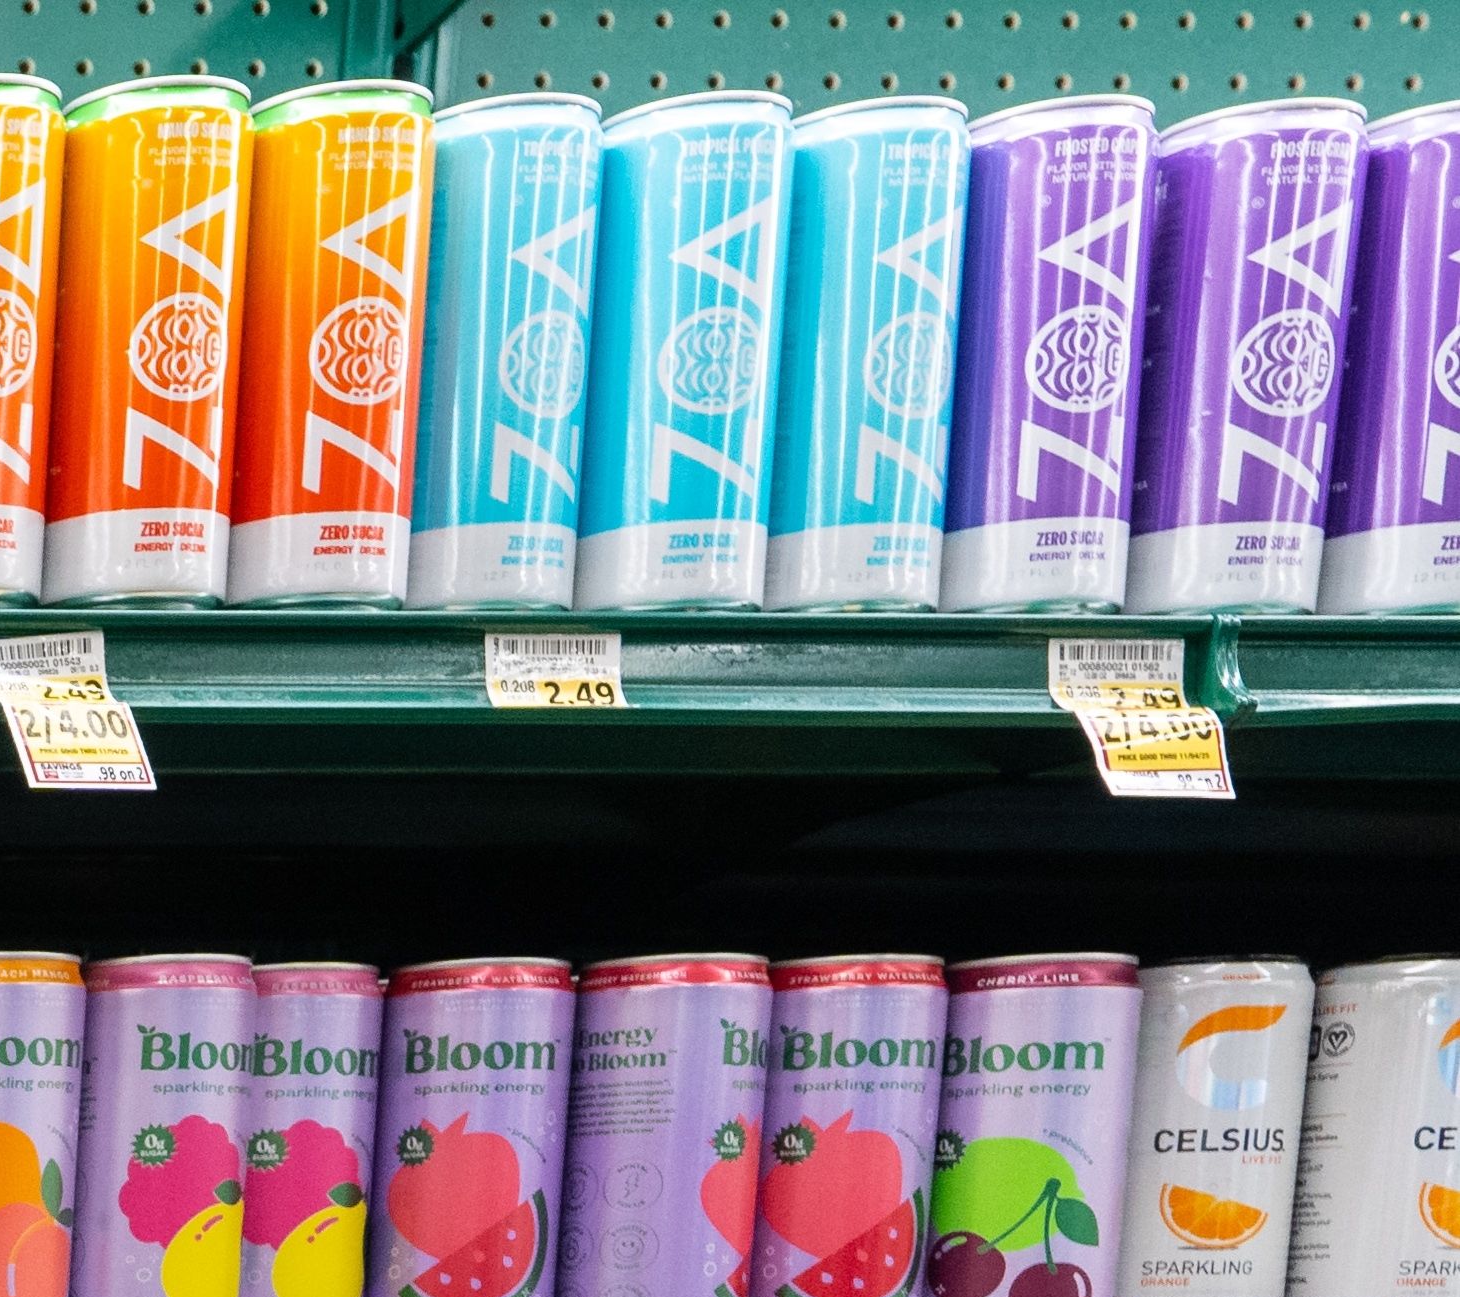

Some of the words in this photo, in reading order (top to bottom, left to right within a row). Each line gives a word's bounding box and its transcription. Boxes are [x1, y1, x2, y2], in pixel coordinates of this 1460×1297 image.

[501, 679, 535, 694] 0.208
[545, 681, 616, 705] 2.49
[977, 975, 1033, 987] CHERRY
[1043, 972, 1079, 983] LIME
[1153, 1127, 1285, 1153] CELSIUS
[1140, 1259, 1253, 1276] SPARKLING
